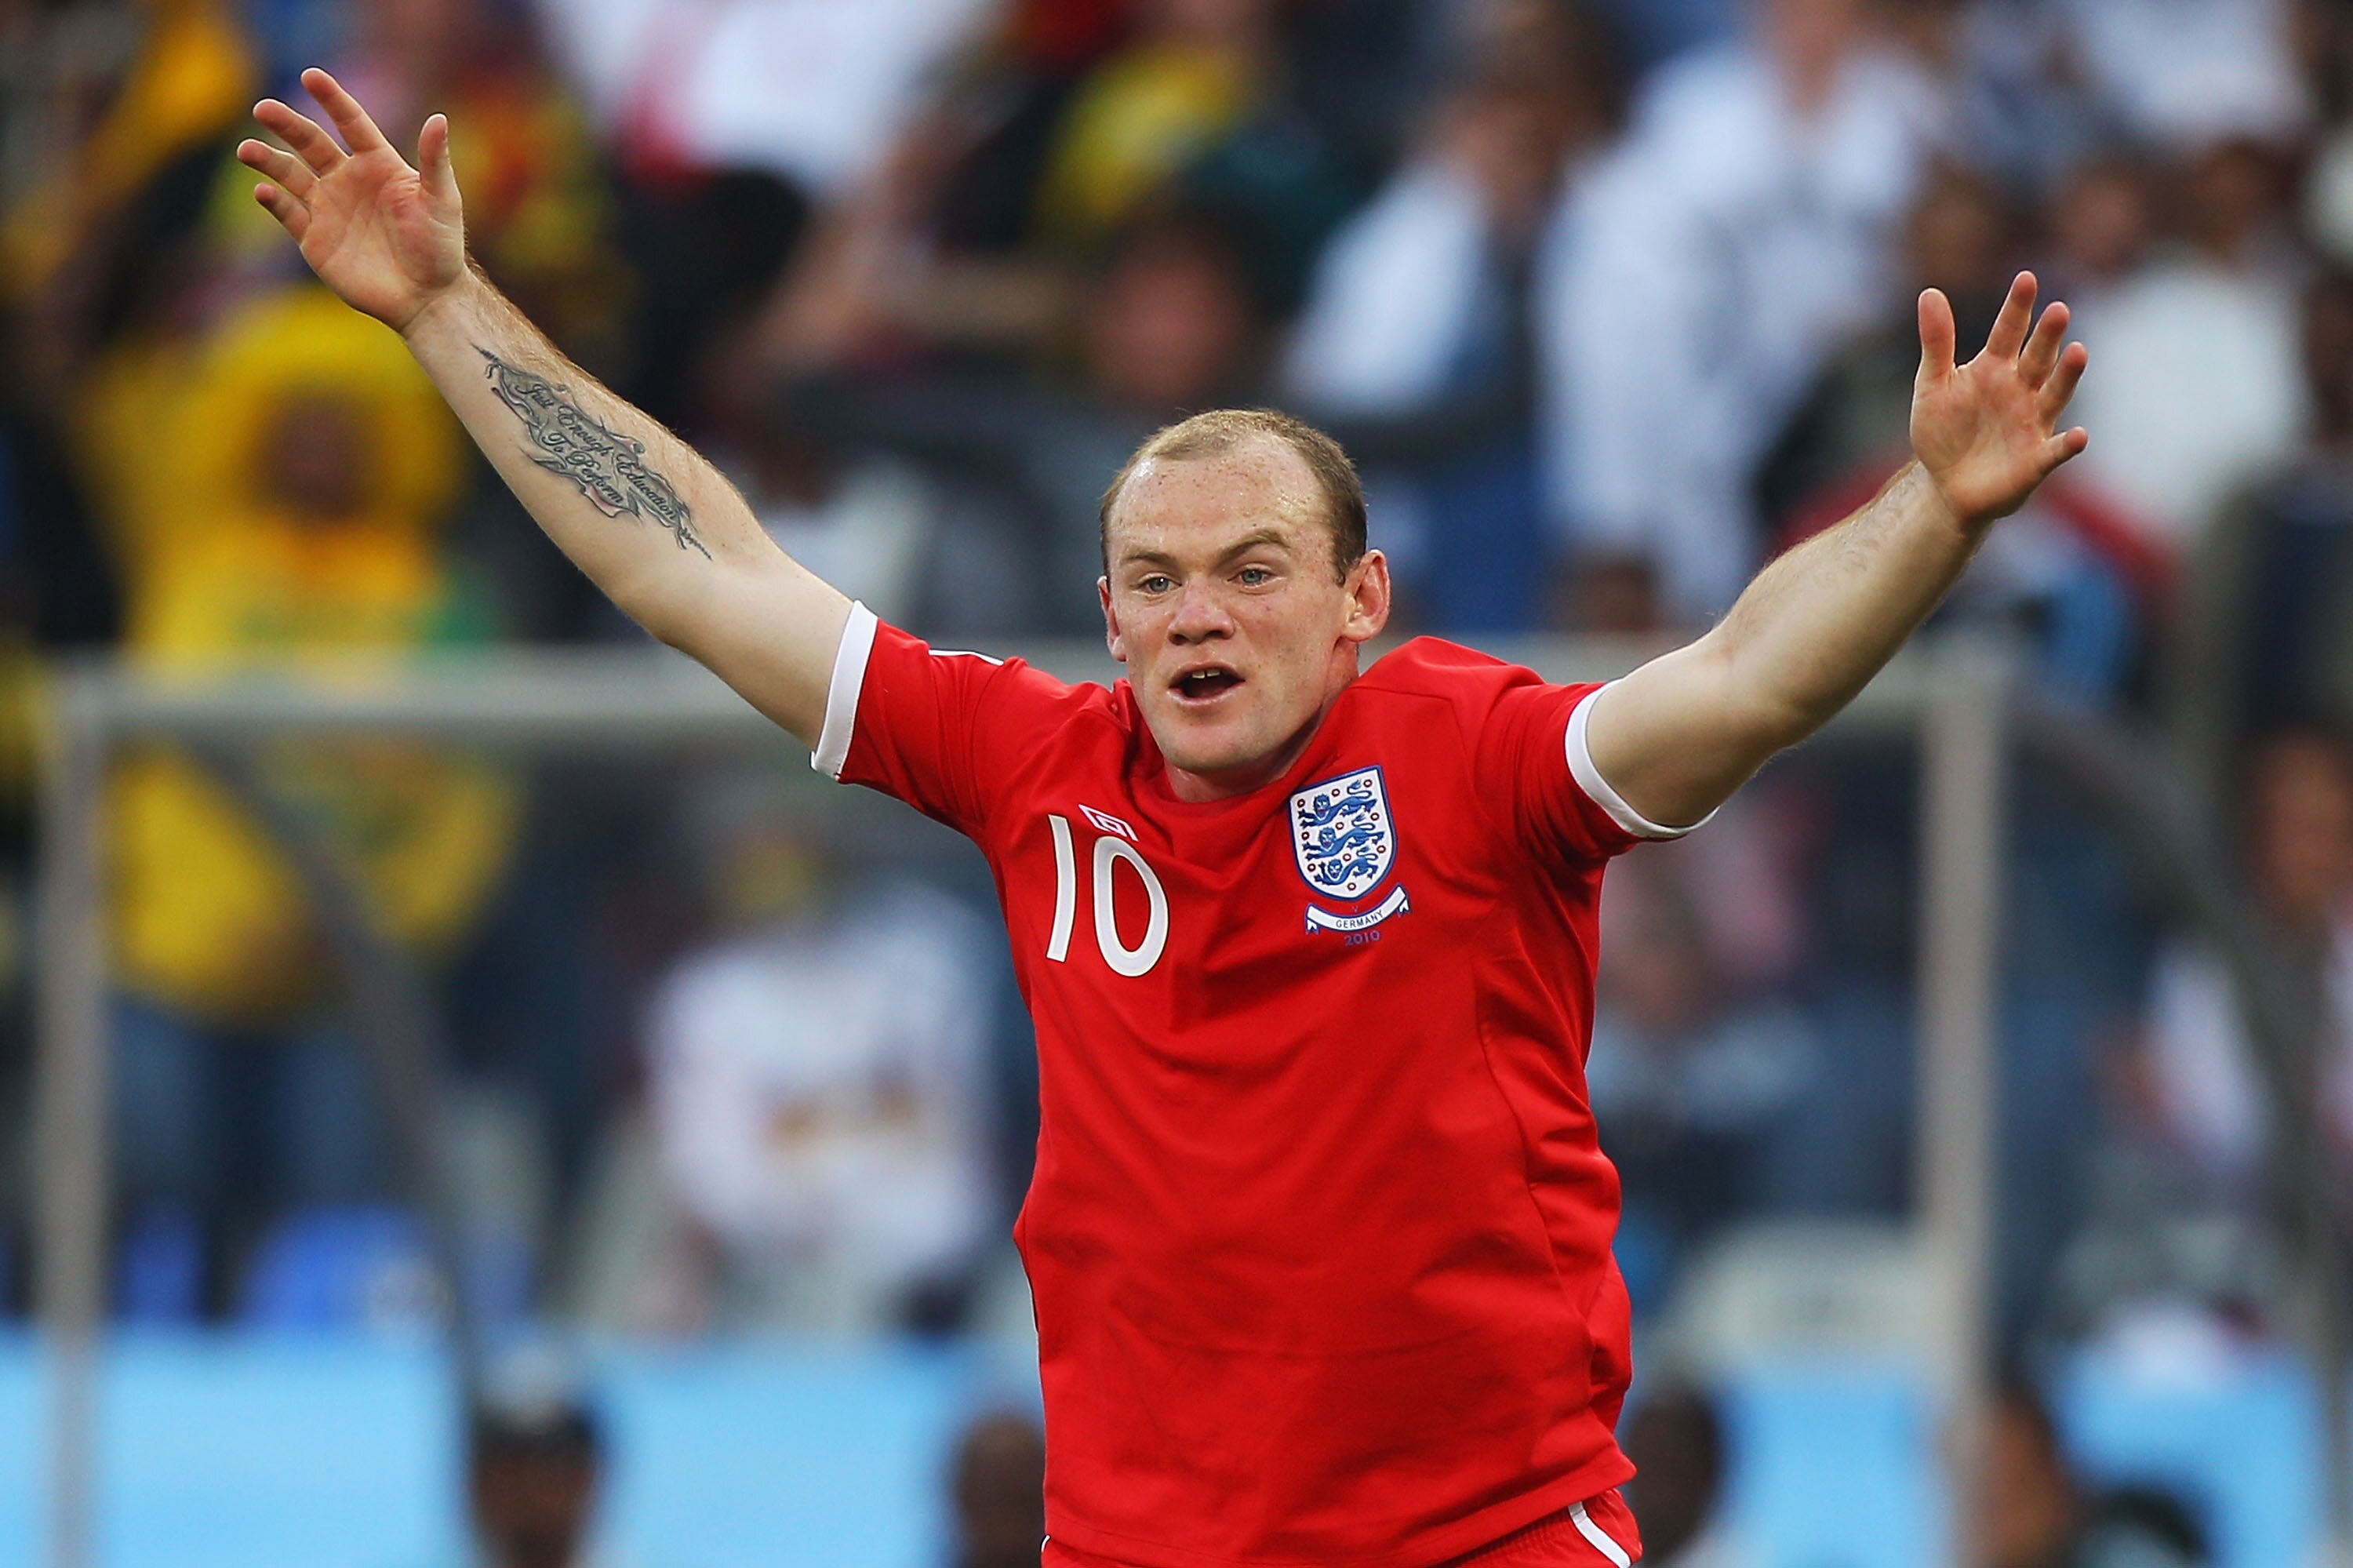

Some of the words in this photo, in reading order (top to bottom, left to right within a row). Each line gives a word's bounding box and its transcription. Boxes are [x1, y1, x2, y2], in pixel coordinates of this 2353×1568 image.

[542, 433, 573, 453] To
[566, 452, 624, 504] Perform
[558, 405, 614, 457] Enough
[616, 453, 676, 520] Education
[1046, 814, 1169, 977] 10
[1336, 910, 1384, 928] GERMANY
[1344, 930, 1380, 946] 2010
